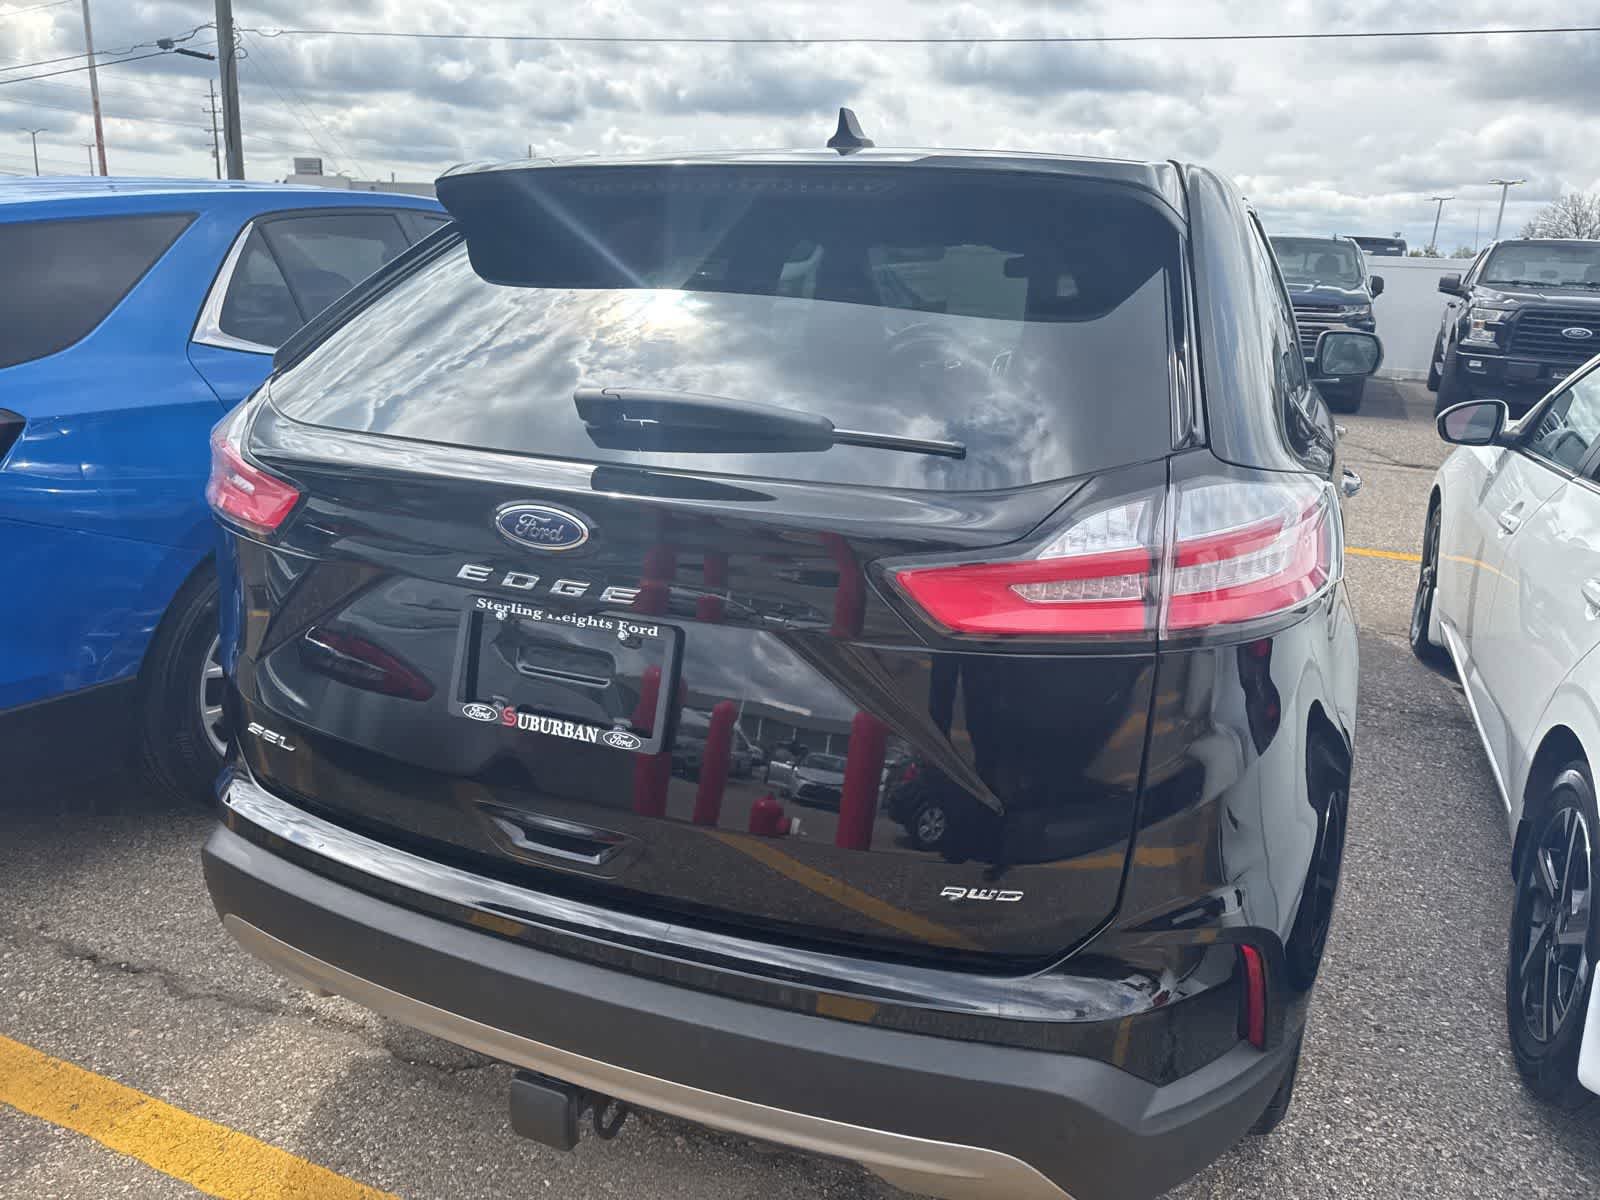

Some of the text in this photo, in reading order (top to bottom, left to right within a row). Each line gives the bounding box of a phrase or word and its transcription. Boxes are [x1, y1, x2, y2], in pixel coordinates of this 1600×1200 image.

[514, 513, 565, 542] Ford
[456, 563, 641, 605] EDGE
[476, 597, 544, 620] Sterling
[617, 620, 659, 638] Ford
[247, 721, 297, 752] SEL
[502, 706, 599, 744] SUBURBAN
[940, 886, 1024, 902] AWD
